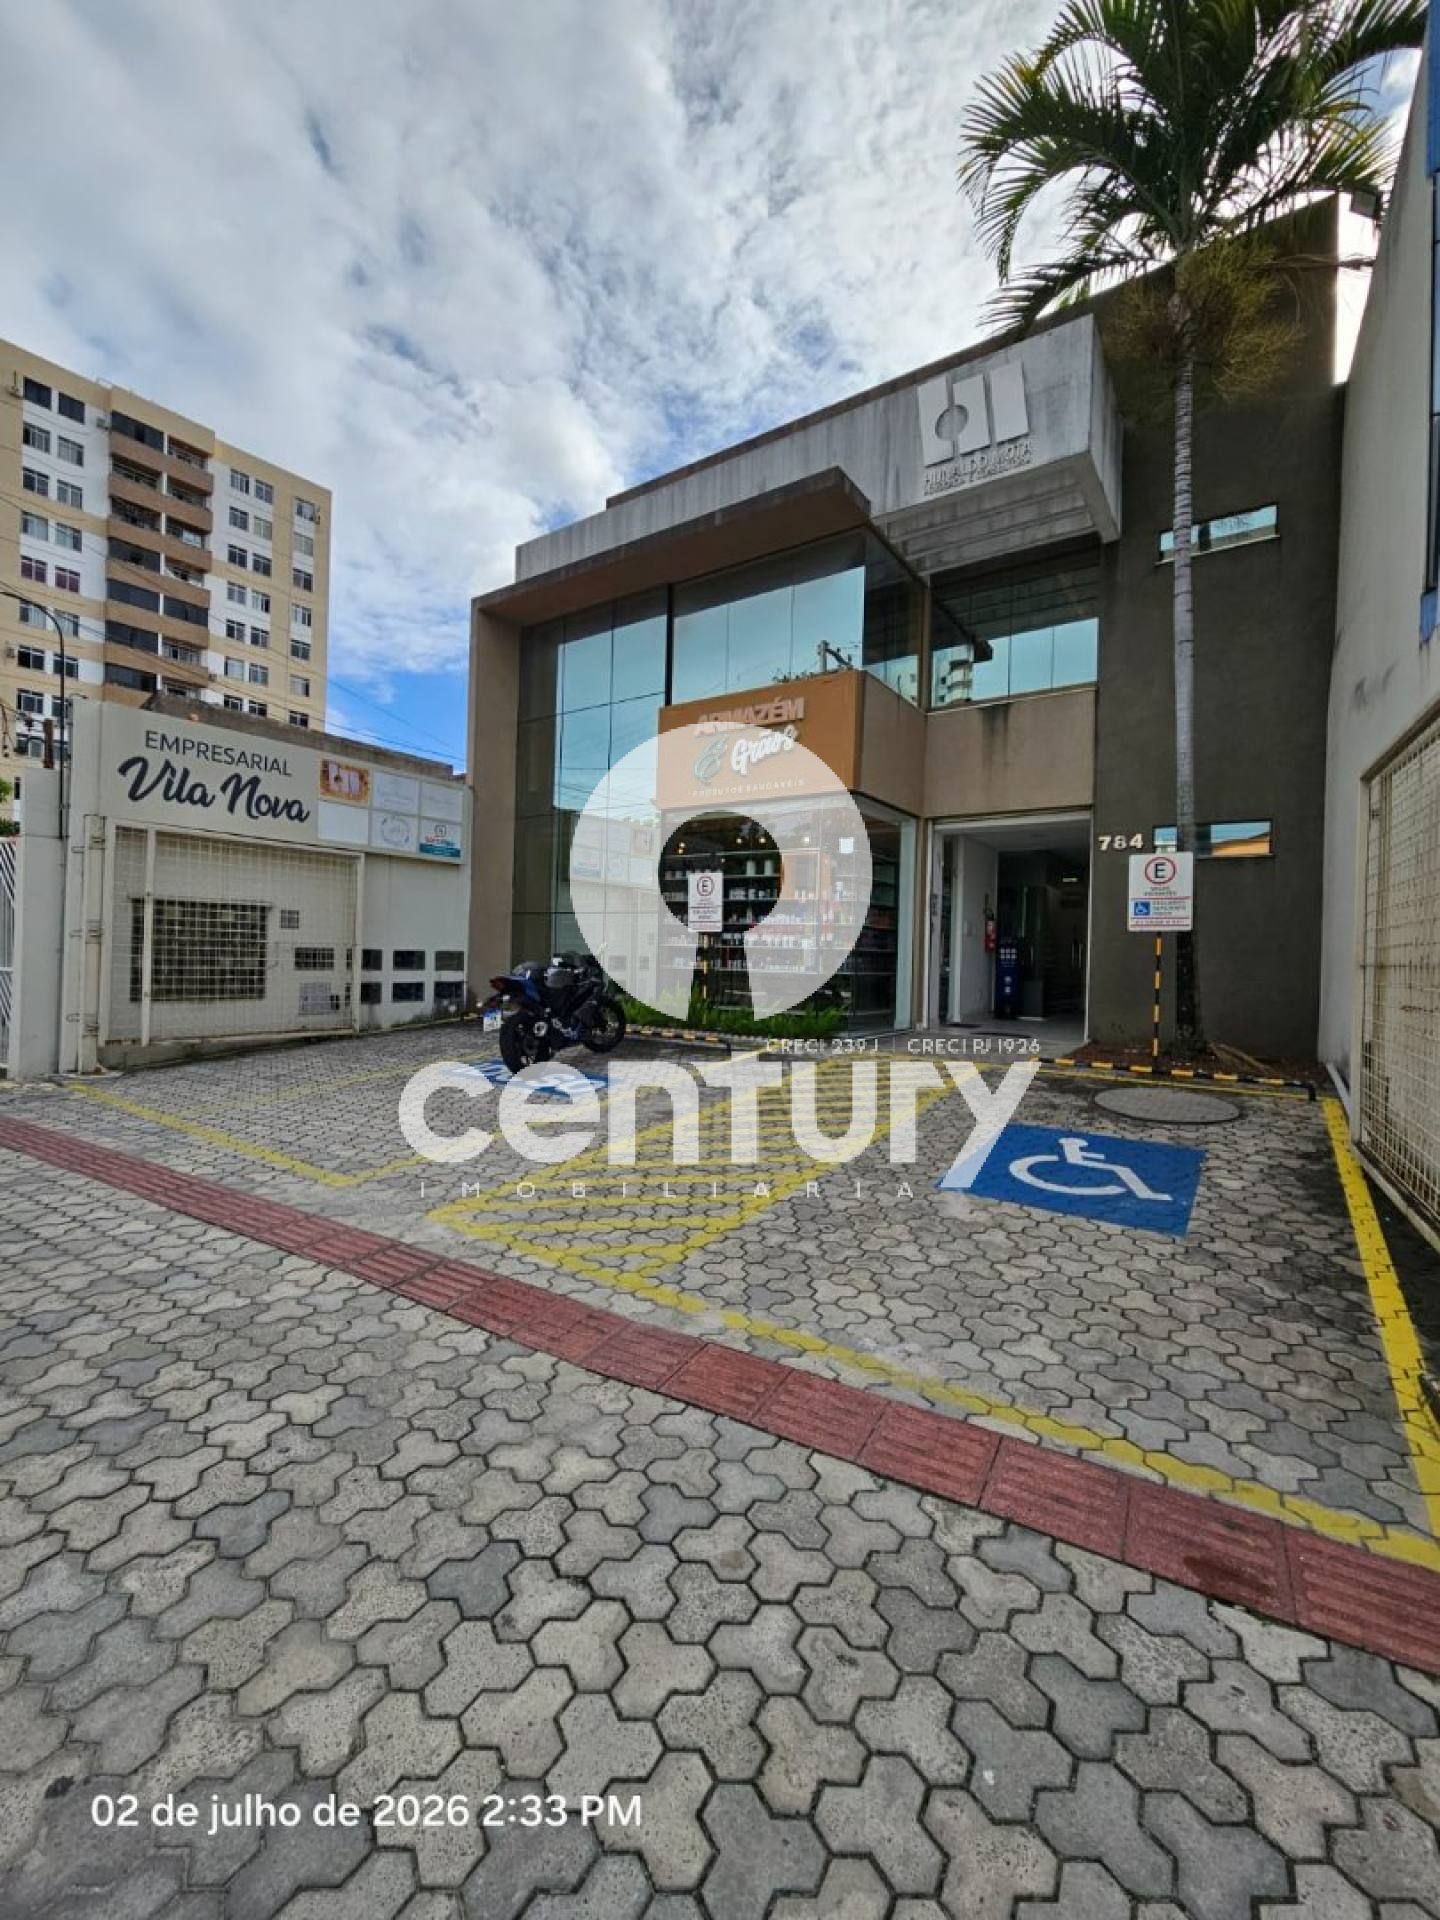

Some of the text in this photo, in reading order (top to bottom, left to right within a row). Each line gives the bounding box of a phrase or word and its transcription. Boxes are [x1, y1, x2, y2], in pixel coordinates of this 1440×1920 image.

[145, 730, 292, 777] EMPRESARIAL
[118, 756, 310, 823] Vila Nova
[1098, 833, 1144, 851] 784
[1154, 861, 1166, 879] E
[701, 879, 709, 893] E
